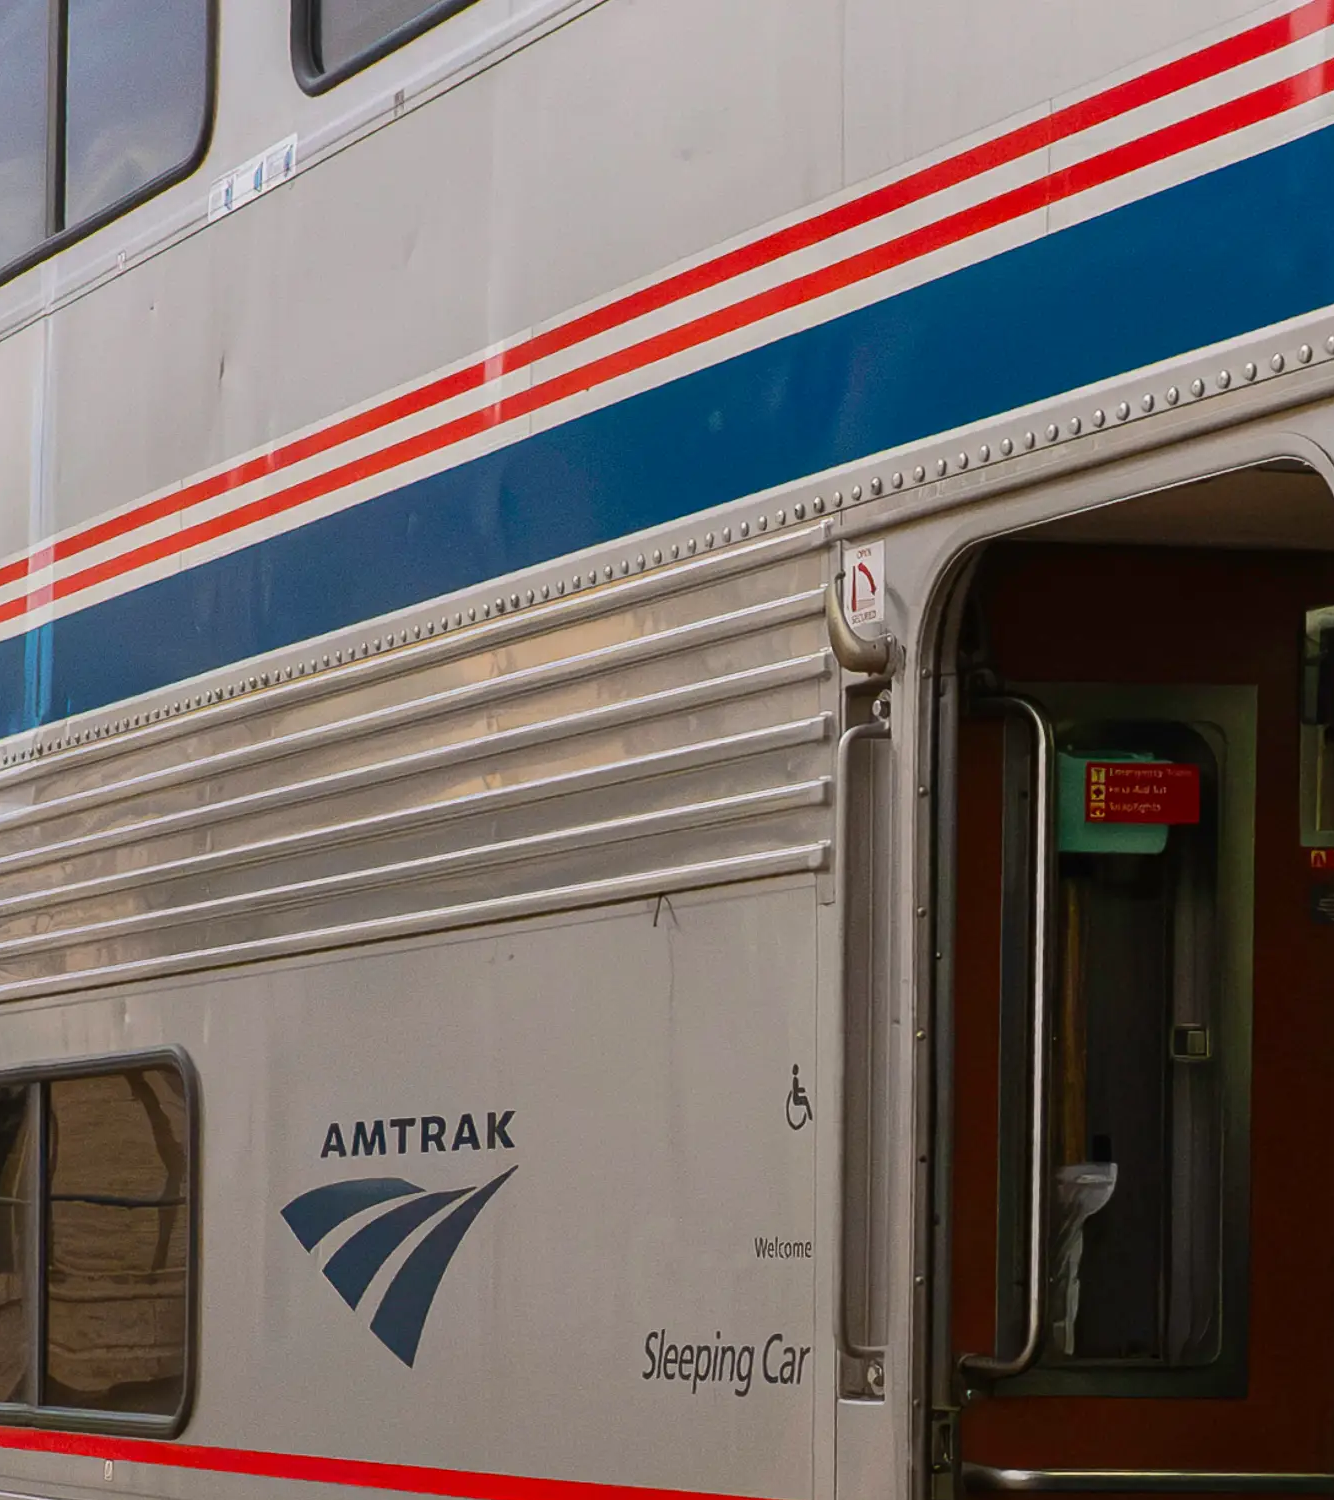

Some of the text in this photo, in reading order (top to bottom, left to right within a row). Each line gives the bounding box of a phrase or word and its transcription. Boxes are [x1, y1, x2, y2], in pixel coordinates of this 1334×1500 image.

[320, 1110, 516, 1159] AMTRAK
[754, 1236, 812, 1259] Welcome
[642, 1328, 811, 1398] Sleeping Car
